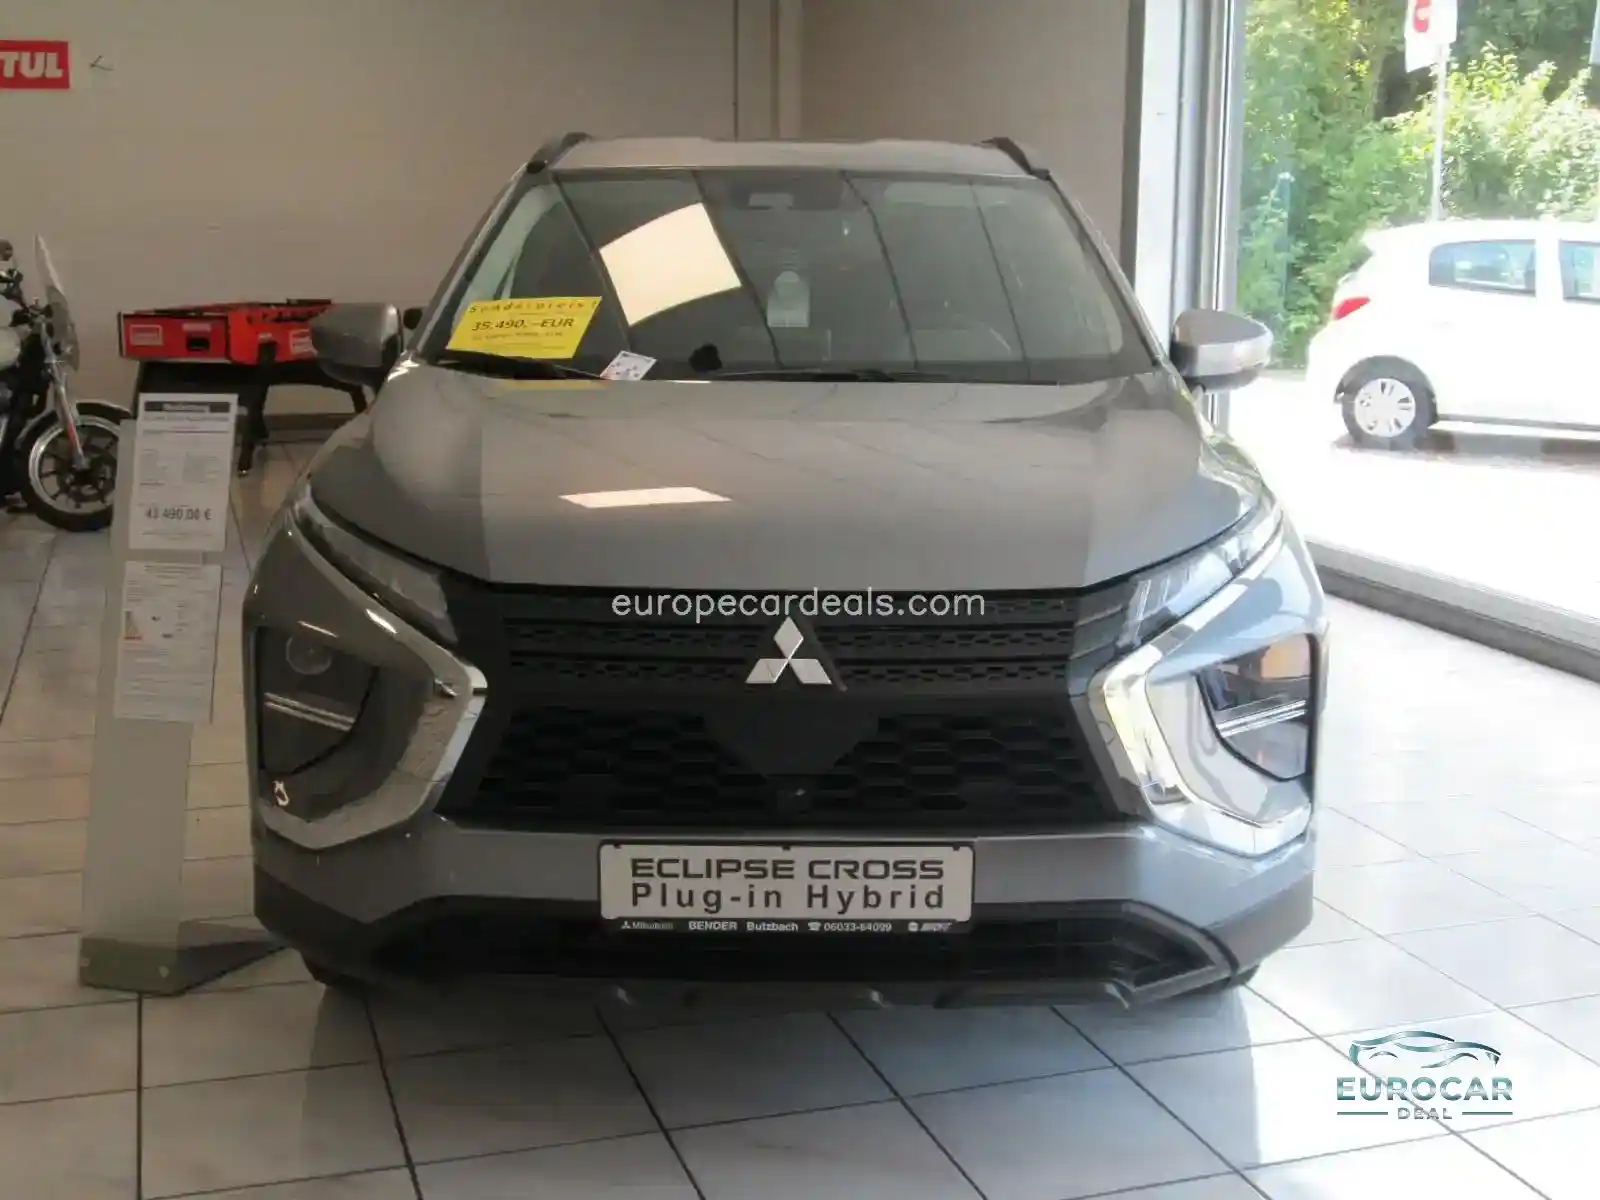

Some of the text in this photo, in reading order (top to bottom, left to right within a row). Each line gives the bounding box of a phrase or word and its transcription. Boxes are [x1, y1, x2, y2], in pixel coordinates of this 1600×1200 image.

[630, 858, 944, 879] ECLIPSE CROSS
[631, 882, 944, 915] Plug-in Hybrid
[688, 920, 738, 931] BENDER
[746, 921, 799, 932] Butzbach
